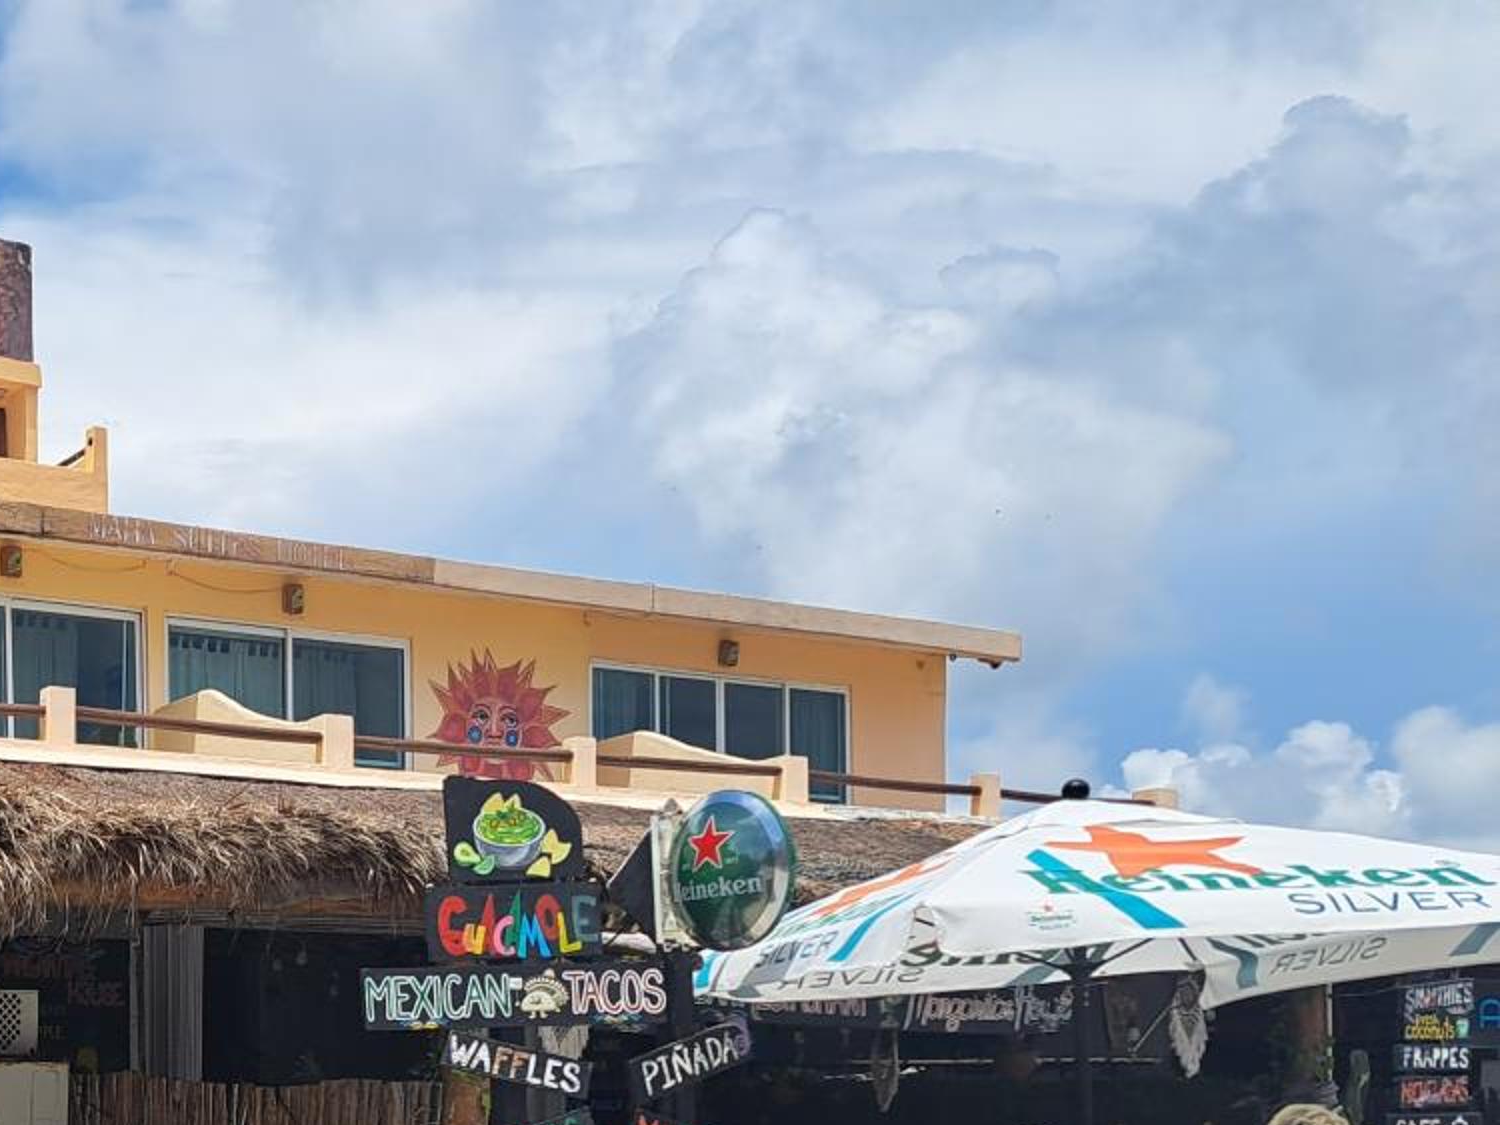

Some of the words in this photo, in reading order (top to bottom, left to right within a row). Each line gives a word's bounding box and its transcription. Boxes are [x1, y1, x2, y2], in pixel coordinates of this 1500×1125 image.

[1019, 863, 1498, 894] Heineken
[437, 890, 599, 959] GUACAMOLE
[1287, 890, 1493, 915] SILVER
[755, 929, 840, 969] SILVER
[363, 973, 513, 1022] MEXICAN
[561, 967, 667, 1016] TACOS
[450, 1034, 582, 1093] WAFFLES
[641, 1032, 740, 1096] PIÑADA
[1402, 1047, 1470, 1069] FRAPPES
